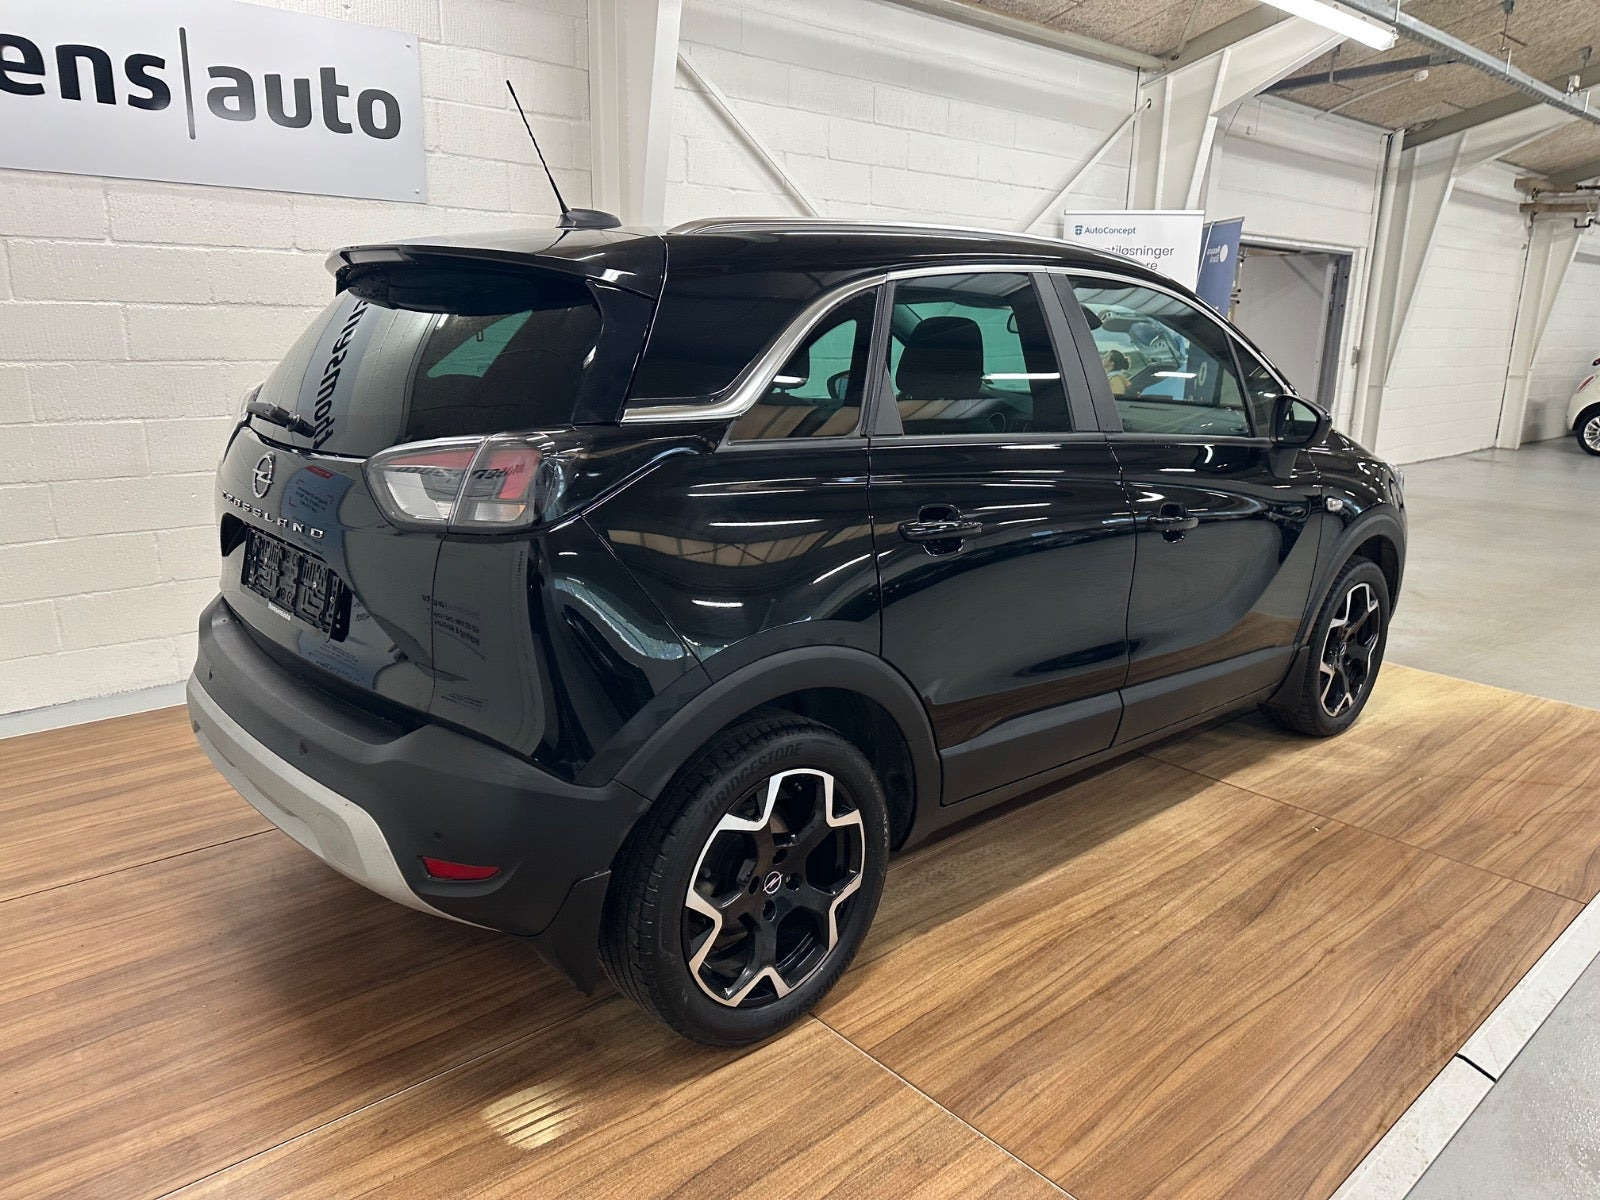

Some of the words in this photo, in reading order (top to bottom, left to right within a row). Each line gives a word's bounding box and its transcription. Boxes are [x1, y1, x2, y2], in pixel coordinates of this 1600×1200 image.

[206, 65, 402, 140] auto
[1084, 226, 1136, 236] AutoConcept
[1105, 245, 1175, 259] tiløsninger
